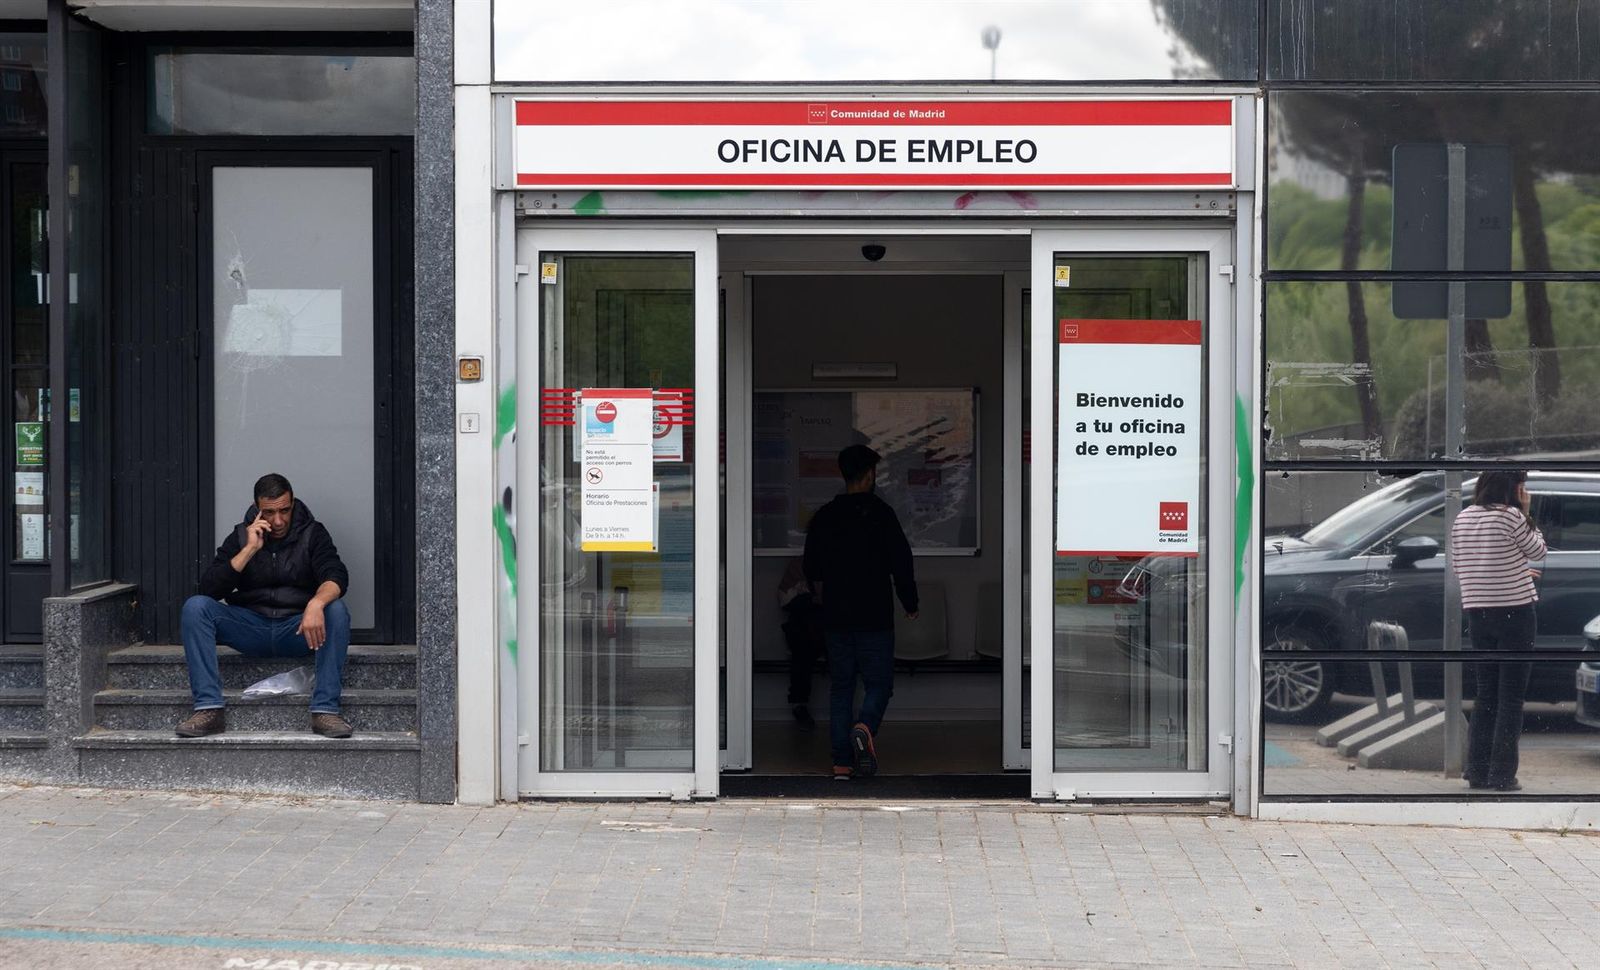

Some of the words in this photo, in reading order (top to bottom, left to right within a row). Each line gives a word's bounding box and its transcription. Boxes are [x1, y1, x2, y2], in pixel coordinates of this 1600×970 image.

[830, 109, 890, 119] Comunidad
[893, 109, 906, 119] de
[909, 109, 946, 119] Madrid
[716, 138, 846, 164] OFICINA
[855, 139, 897, 163] DE
[907, 138, 1038, 164] EMPLEO
[1076, 393, 1184, 409] Bienvenido
[1075, 421, 1087, 433] a
[1093, 419, 1113, 433] tu
[1119, 419, 1186, 434] oficina
[1075, 441, 1099, 456] de
[1105, 442, 1178, 459] empleo
